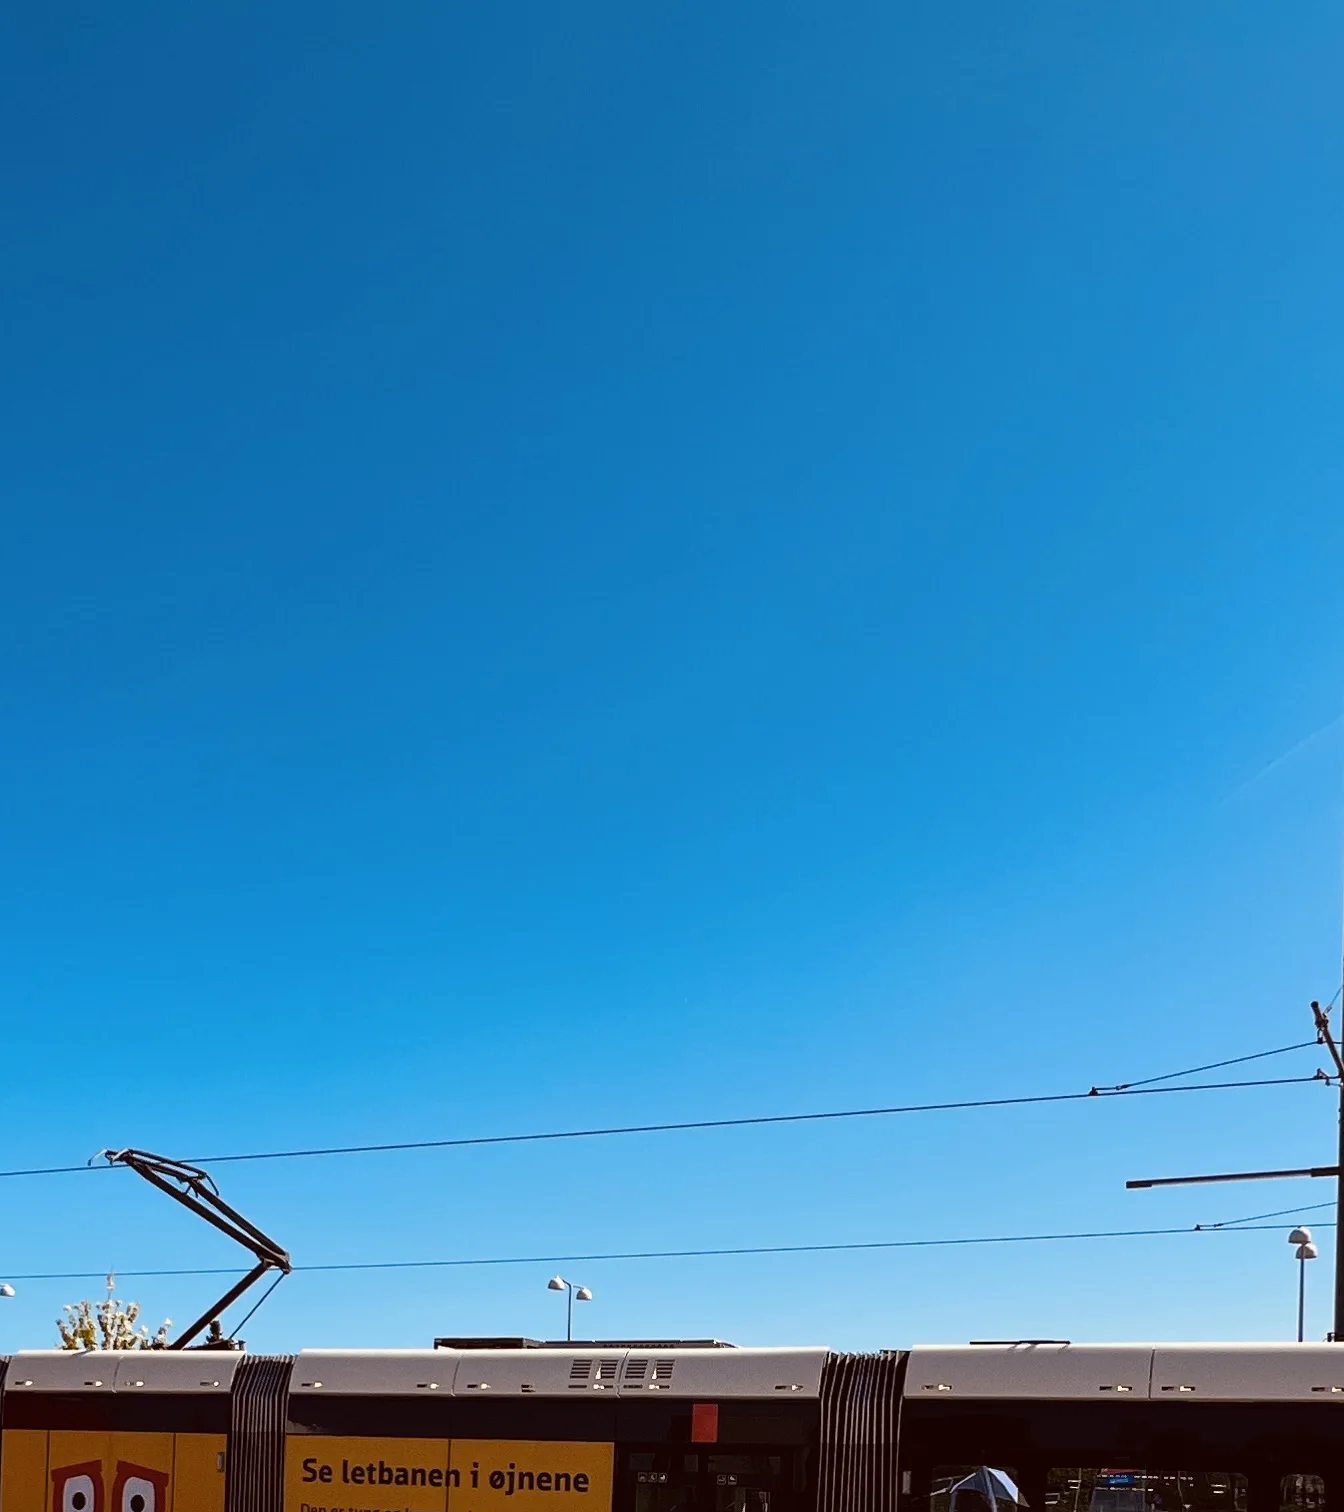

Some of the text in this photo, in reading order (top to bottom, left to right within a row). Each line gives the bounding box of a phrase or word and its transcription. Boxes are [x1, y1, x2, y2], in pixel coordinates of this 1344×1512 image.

[302, 1458, 590, 1495] Se letbanen i øjnene
